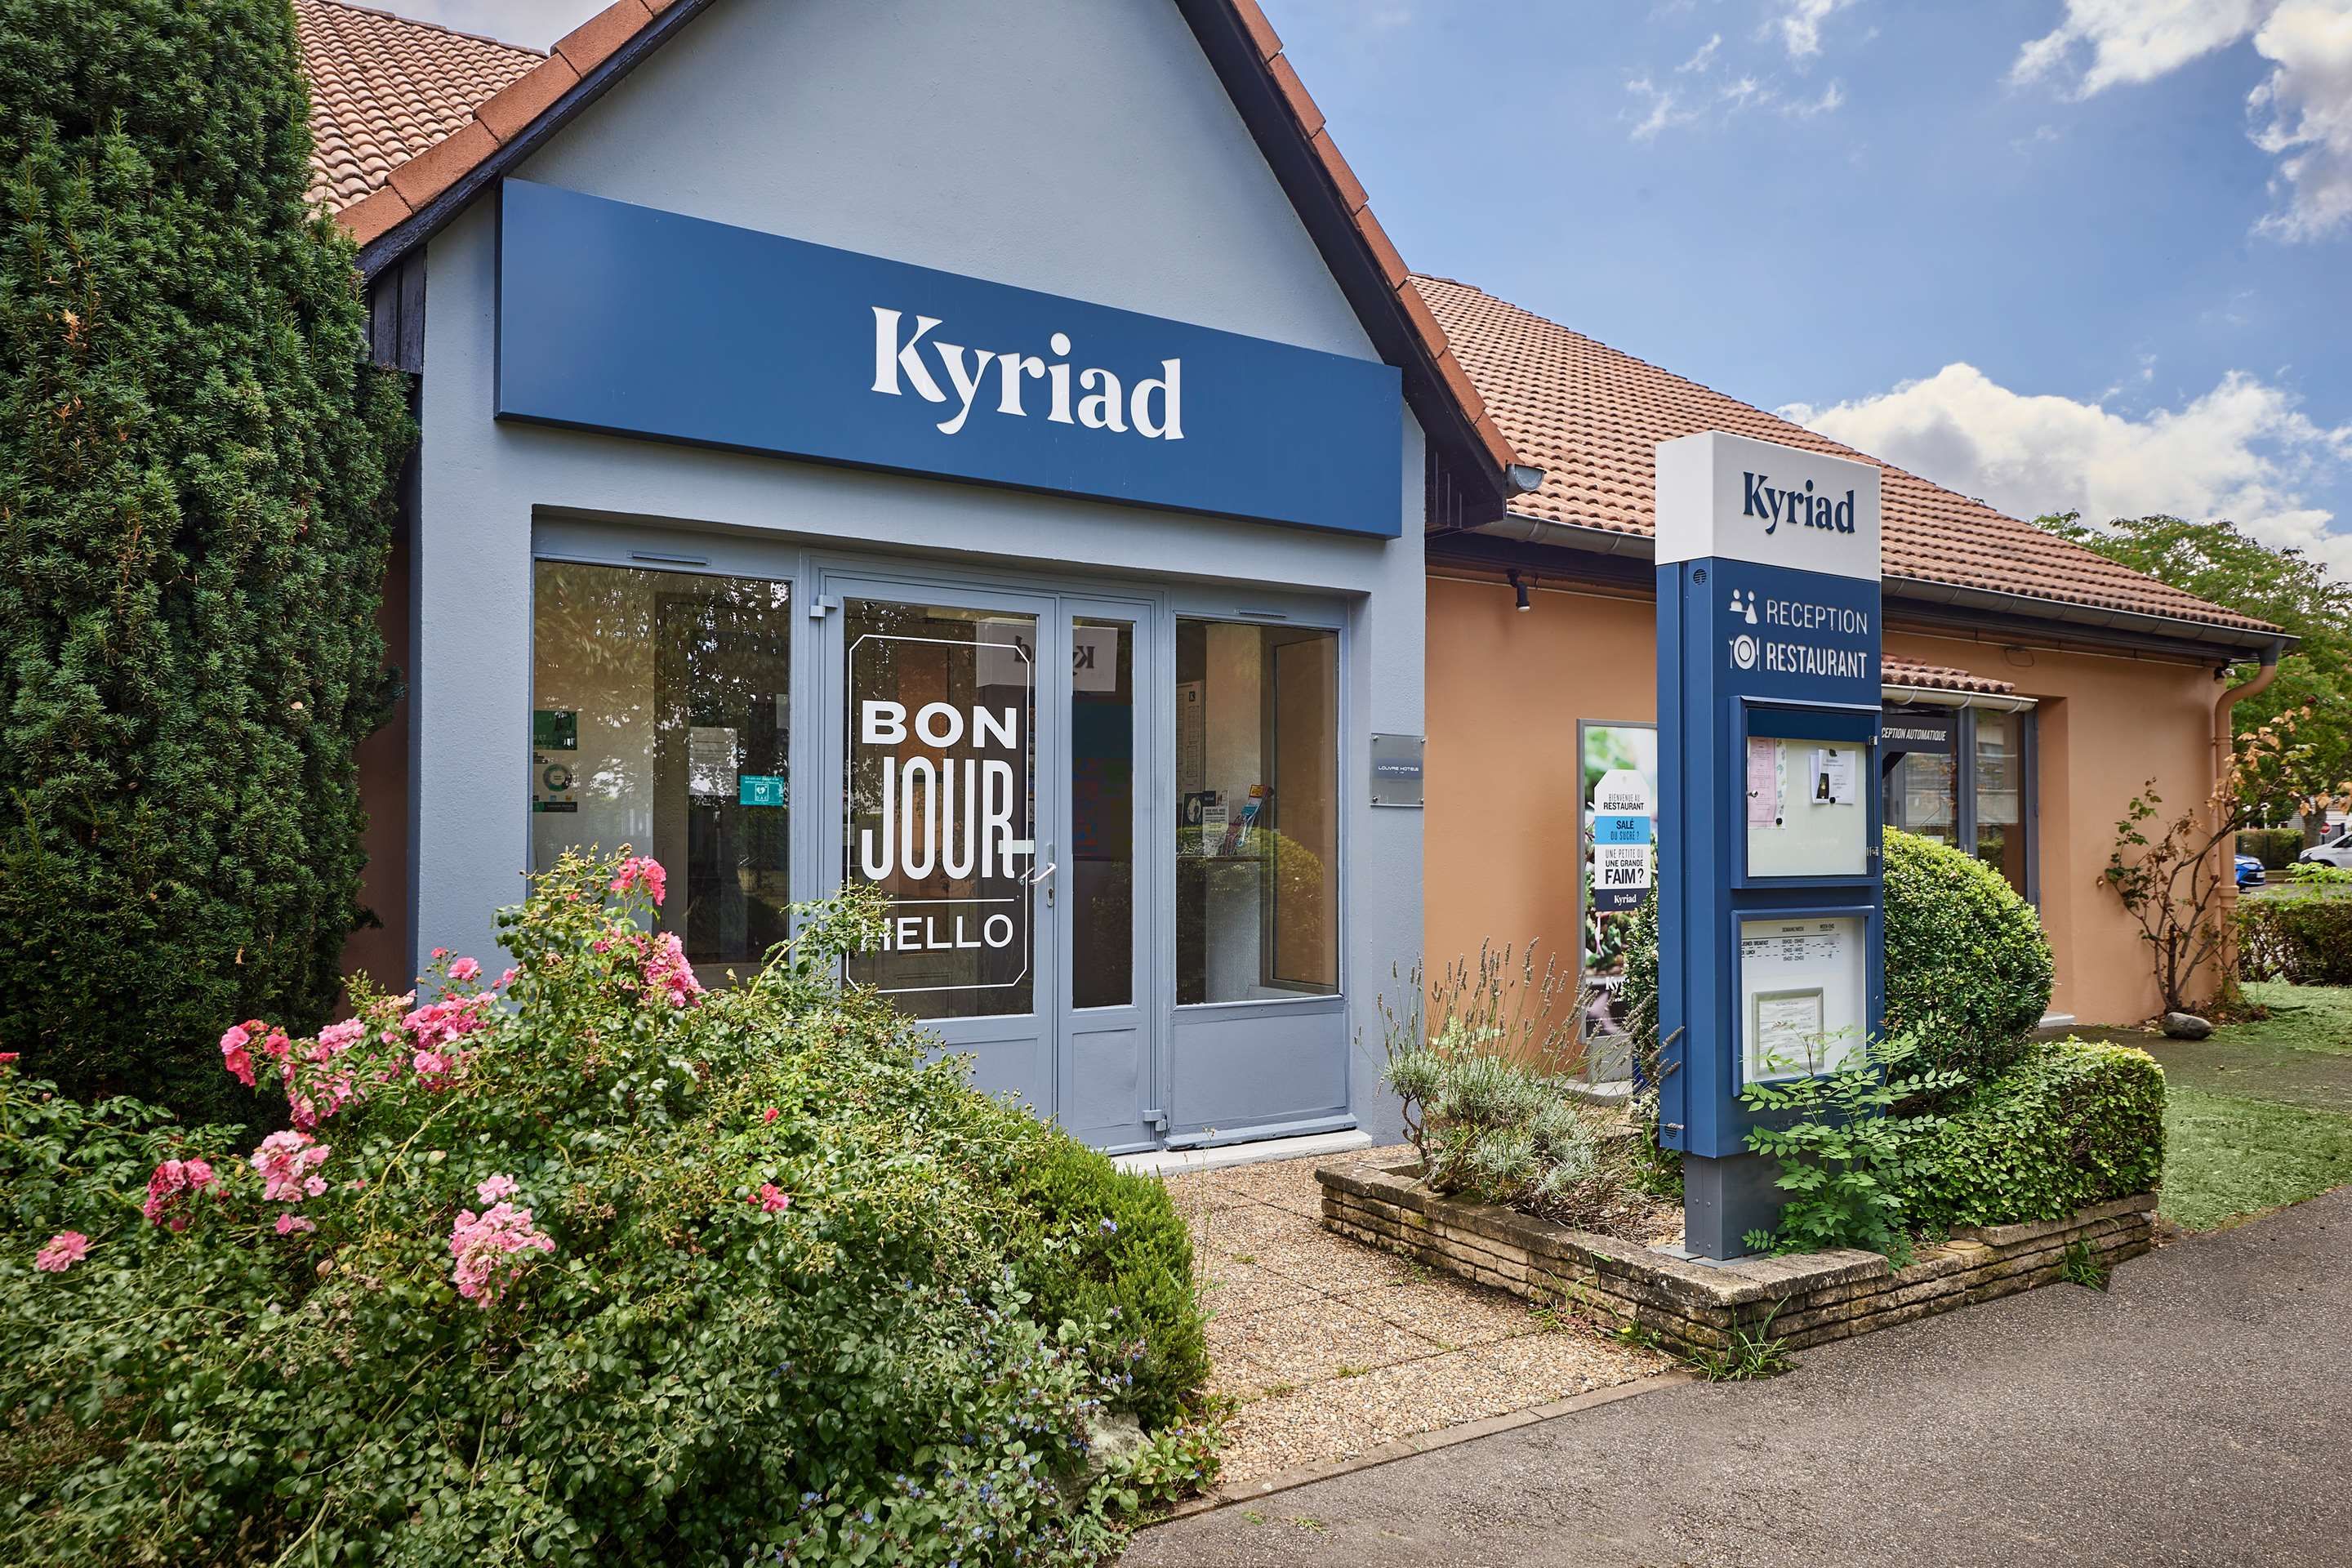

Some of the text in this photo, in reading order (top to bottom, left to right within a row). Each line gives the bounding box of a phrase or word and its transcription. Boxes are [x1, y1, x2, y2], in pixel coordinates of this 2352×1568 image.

[871, 305, 1185, 441] Kyriad
[1743, 471, 1855, 535] Kyriad
[1766, 599, 1868, 635] RECEPTION
[1766, 642, 1868, 679] RESTAURANT
[862, 700, 1017, 749] BON
[1882, 727, 1947, 742] CEPTION AUTOMATIQUE
[1608, 794, 1640, 802] BIENVENUE AU
[1603, 802, 1644, 811] RESTAURANT
[862, 756, 1015, 880] JOUR
[1616, 818, 1634, 830] SALÉ
[1610, 831, 1619, 840] OU
[1606, 849, 1643, 858] UNE PETITE OU
[1620, 859, 1643, 867] GRANDE
[1606, 869, 1635, 884] FAIM
[1614, 893, 1637, 906] Kyriad
